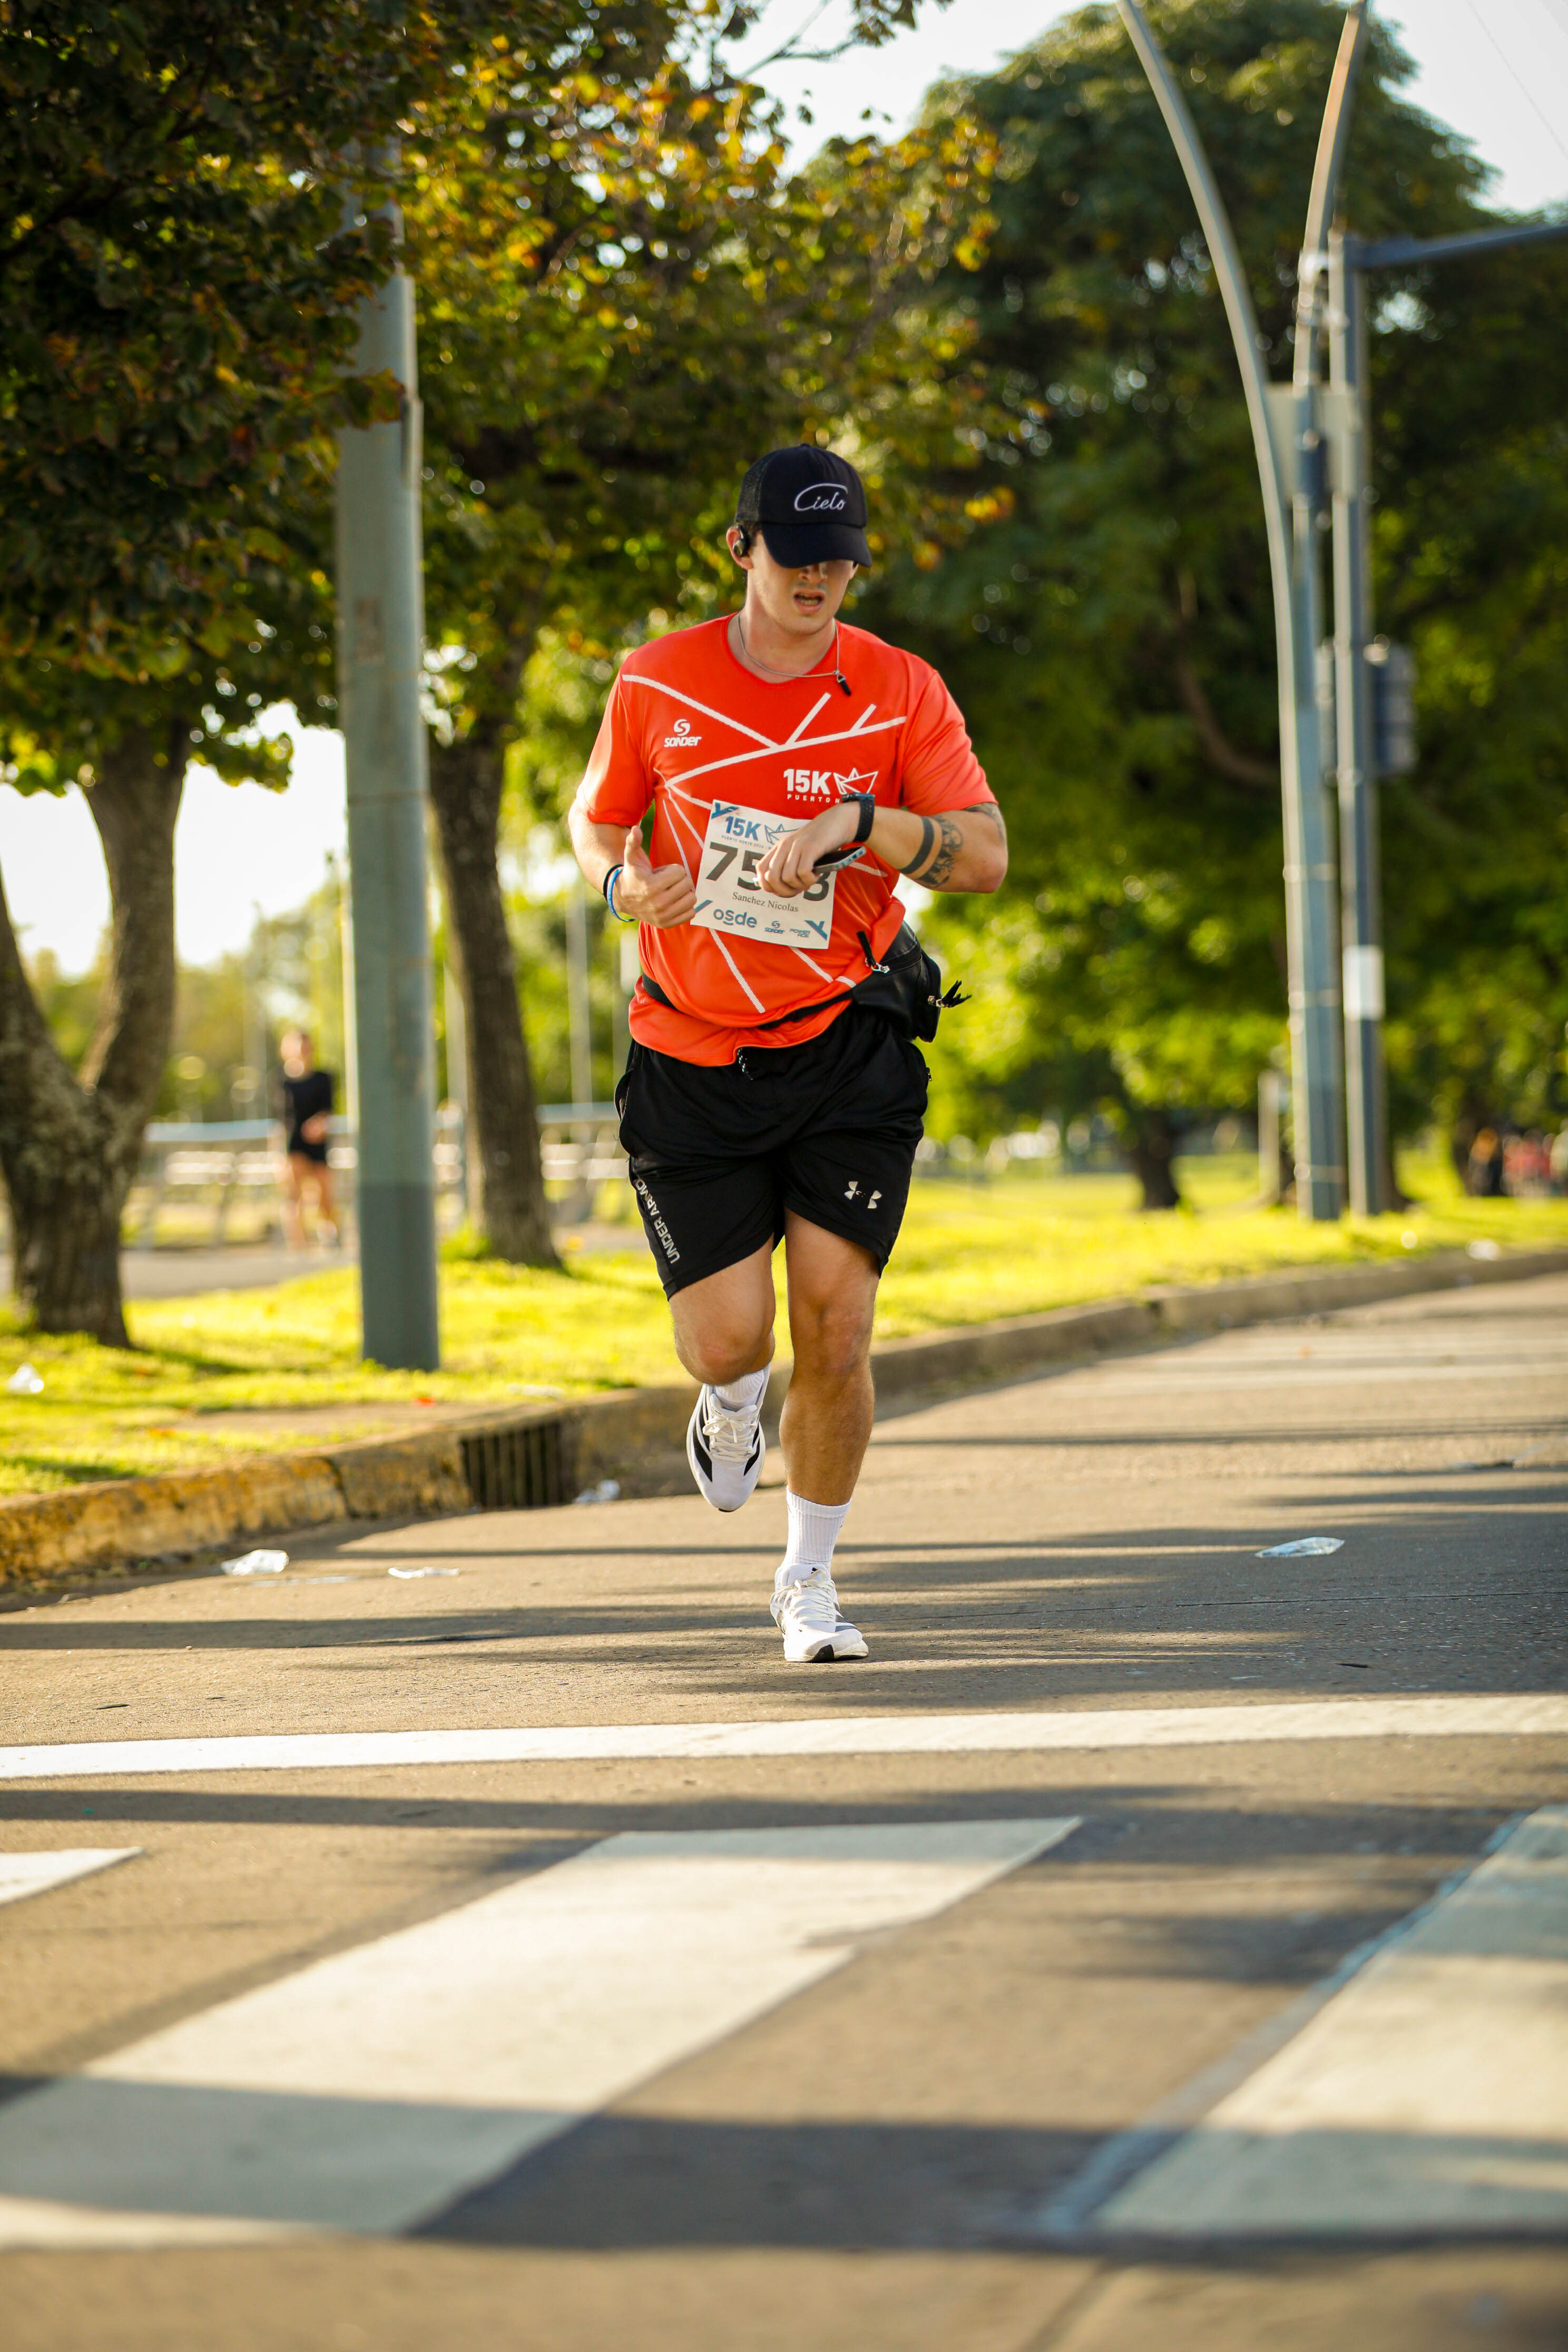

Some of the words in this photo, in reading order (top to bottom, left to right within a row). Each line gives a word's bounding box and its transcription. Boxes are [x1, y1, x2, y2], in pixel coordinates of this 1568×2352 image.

[794, 483, 848, 511] Cielo
[783, 769, 832, 795] 15K
[787, 793, 831, 803] PUERTO
[725, 816, 761, 841] 15K
[705, 841, 829, 901] 753
[732, 891, 766, 907] Sanchez
[767, 899, 799, 913] Nicolas
[713, 908, 757, 928] osde
[654, 1216, 680, 1264] UNDER
